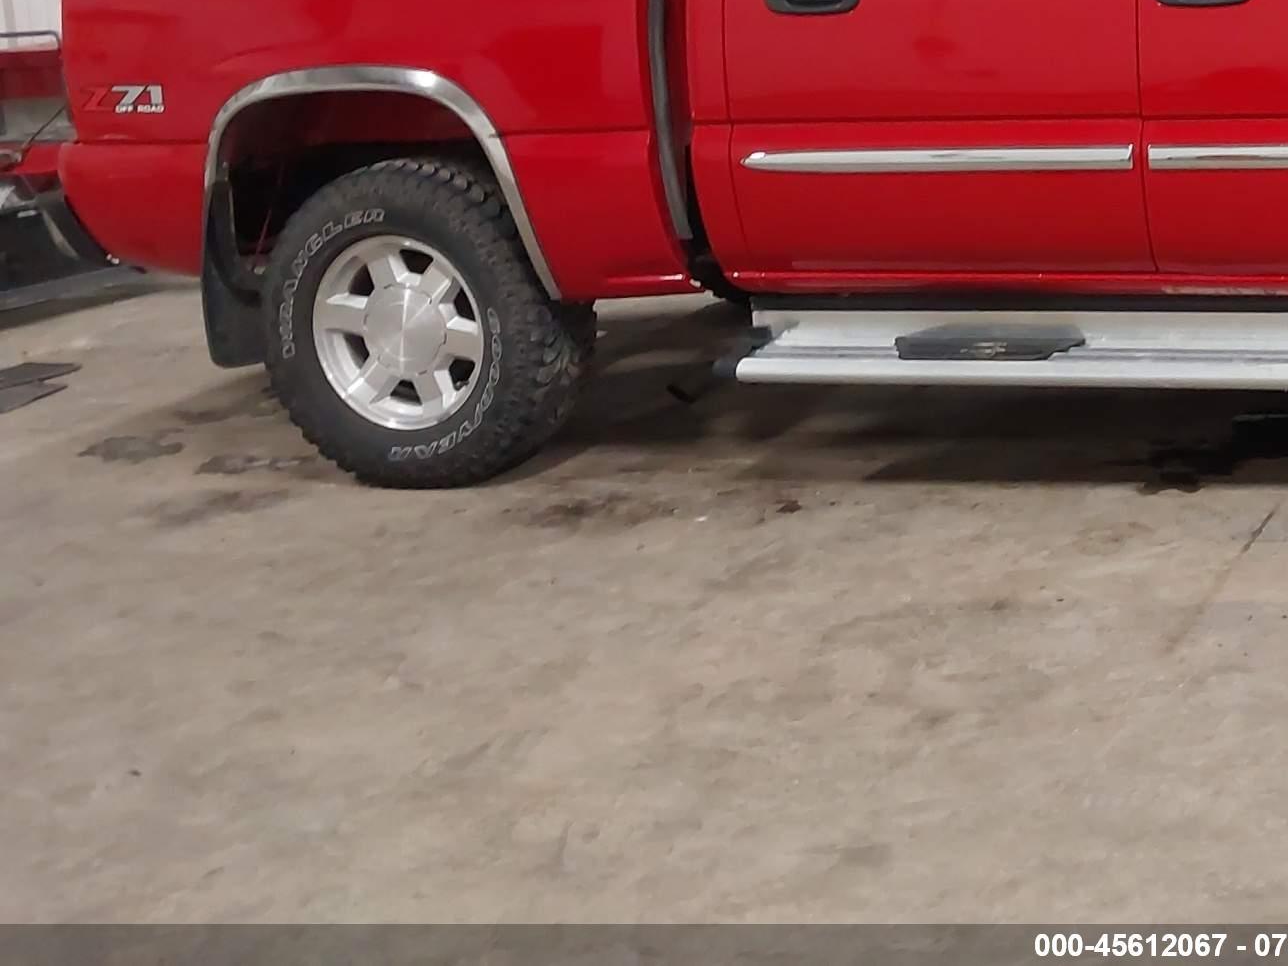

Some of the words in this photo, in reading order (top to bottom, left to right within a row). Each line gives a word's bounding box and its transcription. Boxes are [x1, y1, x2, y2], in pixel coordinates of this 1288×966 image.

[80, 84, 163, 111] Z71
[279, 208, 385, 360] WRANGLER
[388, 307, 503, 462] GOODYEAR
